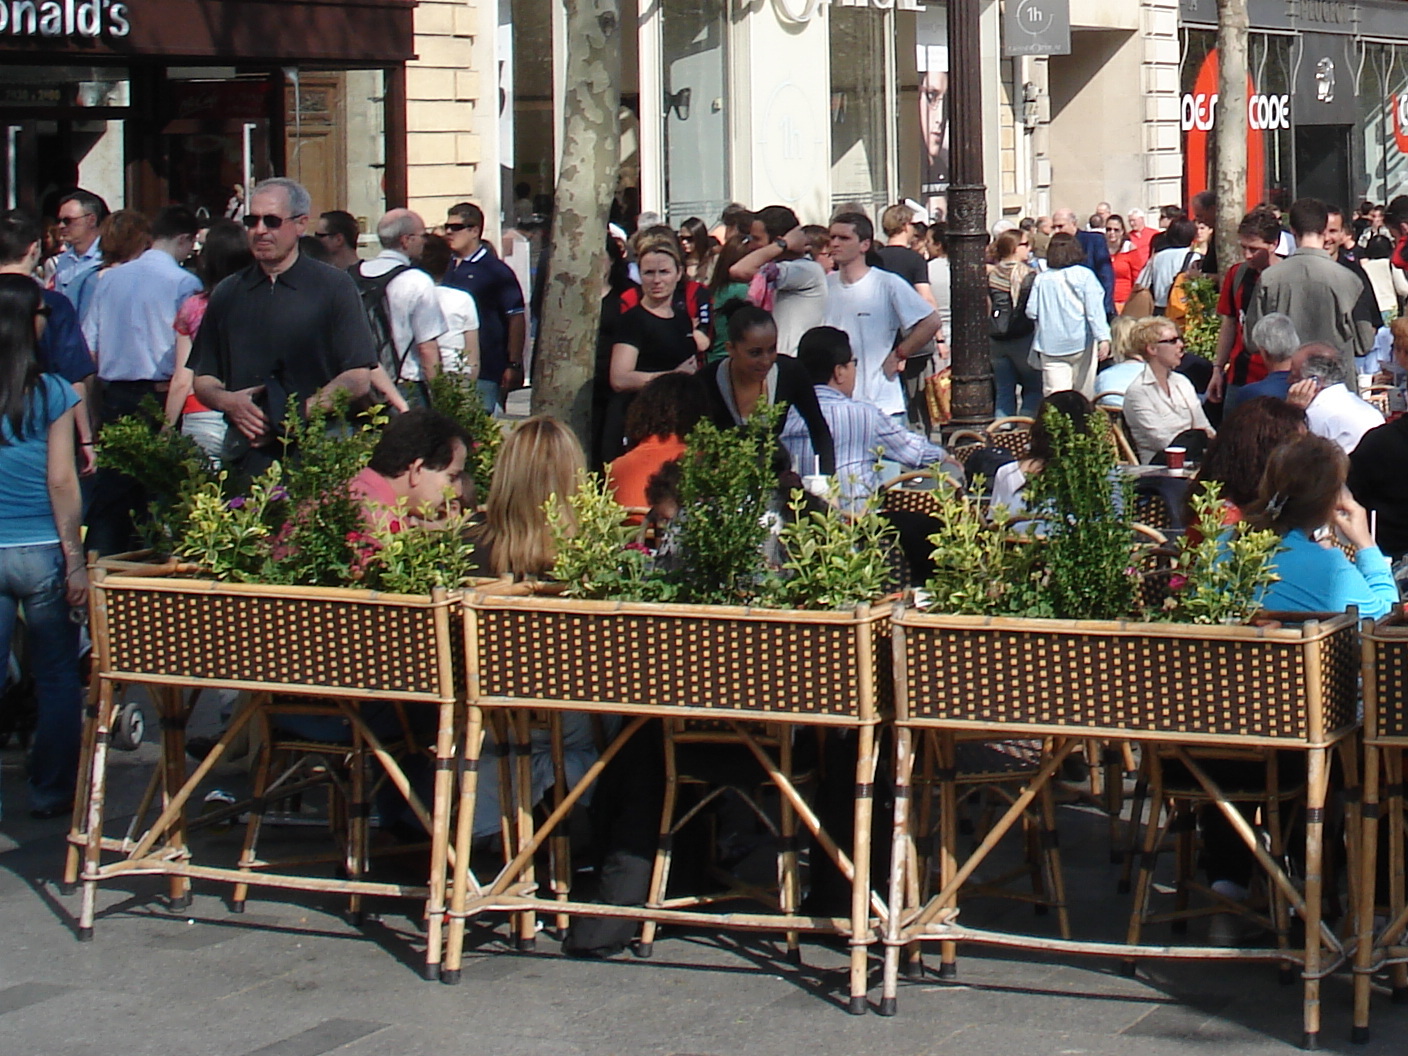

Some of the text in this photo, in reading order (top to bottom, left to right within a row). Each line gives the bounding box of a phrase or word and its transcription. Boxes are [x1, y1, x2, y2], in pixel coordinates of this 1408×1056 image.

[1026, 6, 1043, 22] 1h
[1181, 93, 1290, 131] DES CODE
